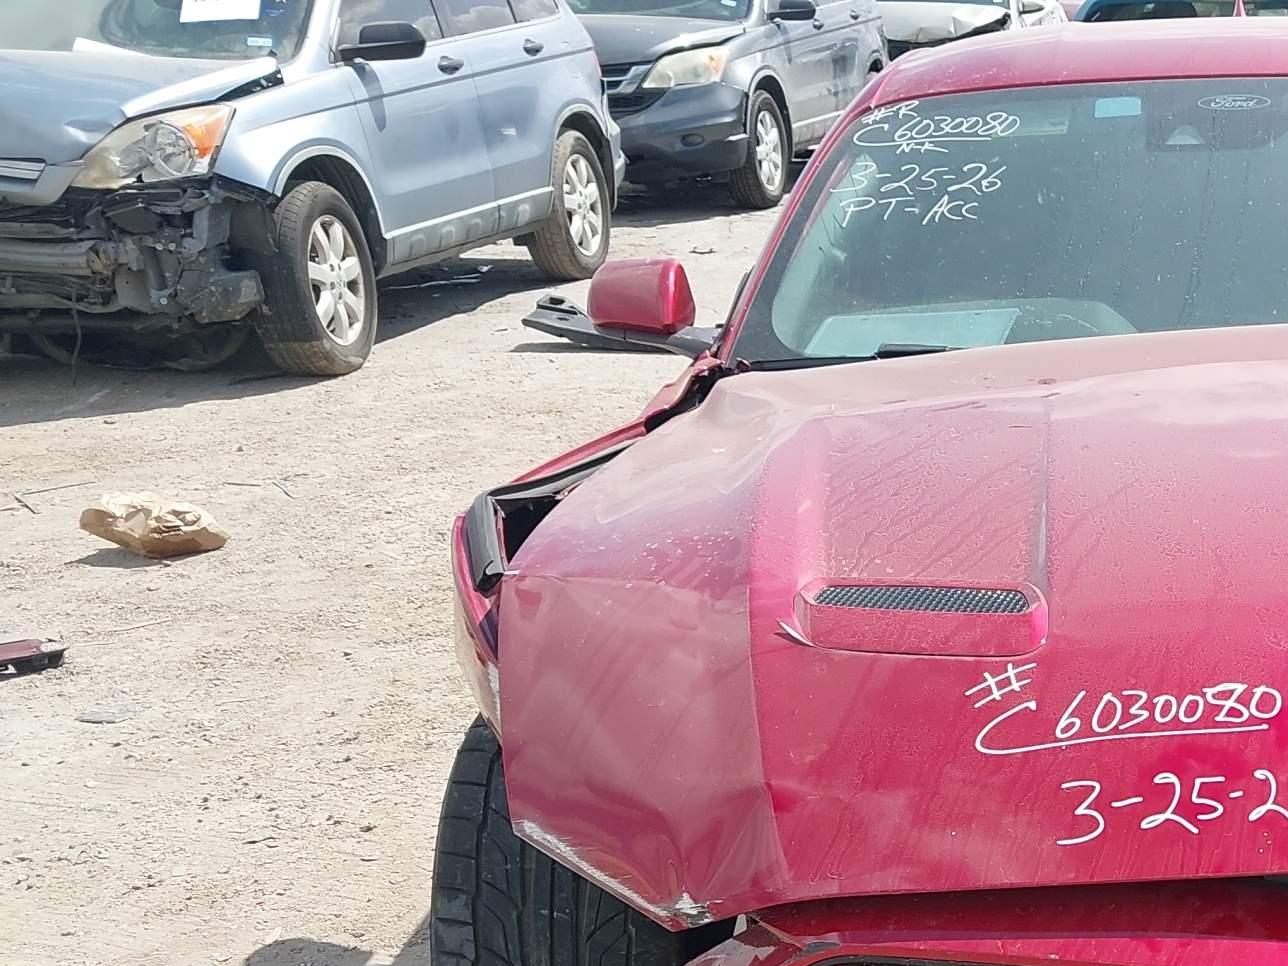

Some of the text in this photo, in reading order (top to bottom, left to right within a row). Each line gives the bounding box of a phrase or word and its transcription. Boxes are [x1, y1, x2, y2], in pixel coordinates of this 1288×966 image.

[1210, 96, 1259, 108] Ford
[853, 111, 1021, 147] C6030080
[830, 161, 1007, 195] 3-25-26
